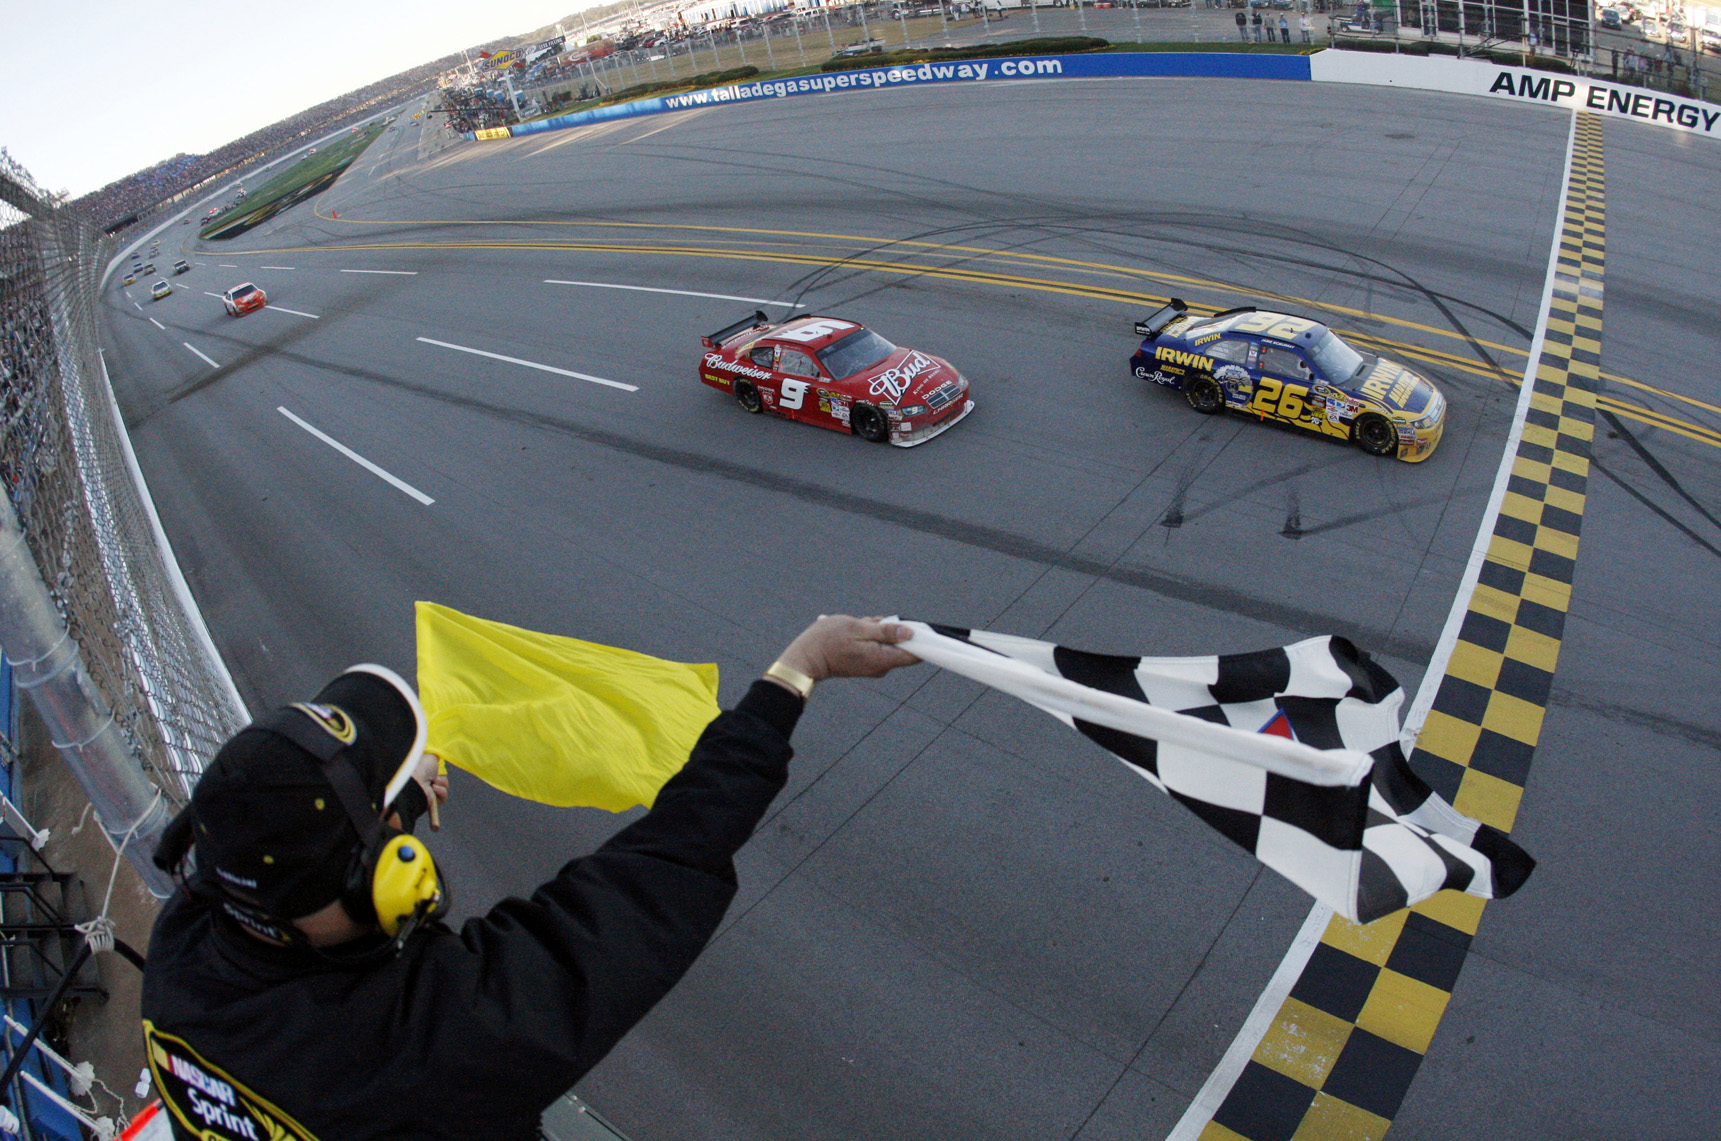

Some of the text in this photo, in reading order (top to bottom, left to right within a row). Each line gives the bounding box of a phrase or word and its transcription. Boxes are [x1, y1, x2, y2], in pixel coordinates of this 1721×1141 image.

[484, 50, 521, 70] SUNOCO
[1489, 71, 1721, 132] AMP ENERGY
[1194, 332, 1222, 346] IRWIN
[704, 352, 773, 380] Budweiser
[1155, 346, 1214, 372] IRWIN
[869, 352, 931, 397] Bud
[1135, 366, 1155, 379] Crown
[1149, 370, 1176, 385] Royal
[1360, 362, 1402, 401] IRWIN
[779, 377, 813, 410] 9
[921, 380, 953, 400] DODGE
[1252, 376, 1310, 420] 26
[1346, 405, 1359, 413] 3M
[171, 1054, 236, 1107] NASCAR
[187, 1086, 259, 1141] Sprint
